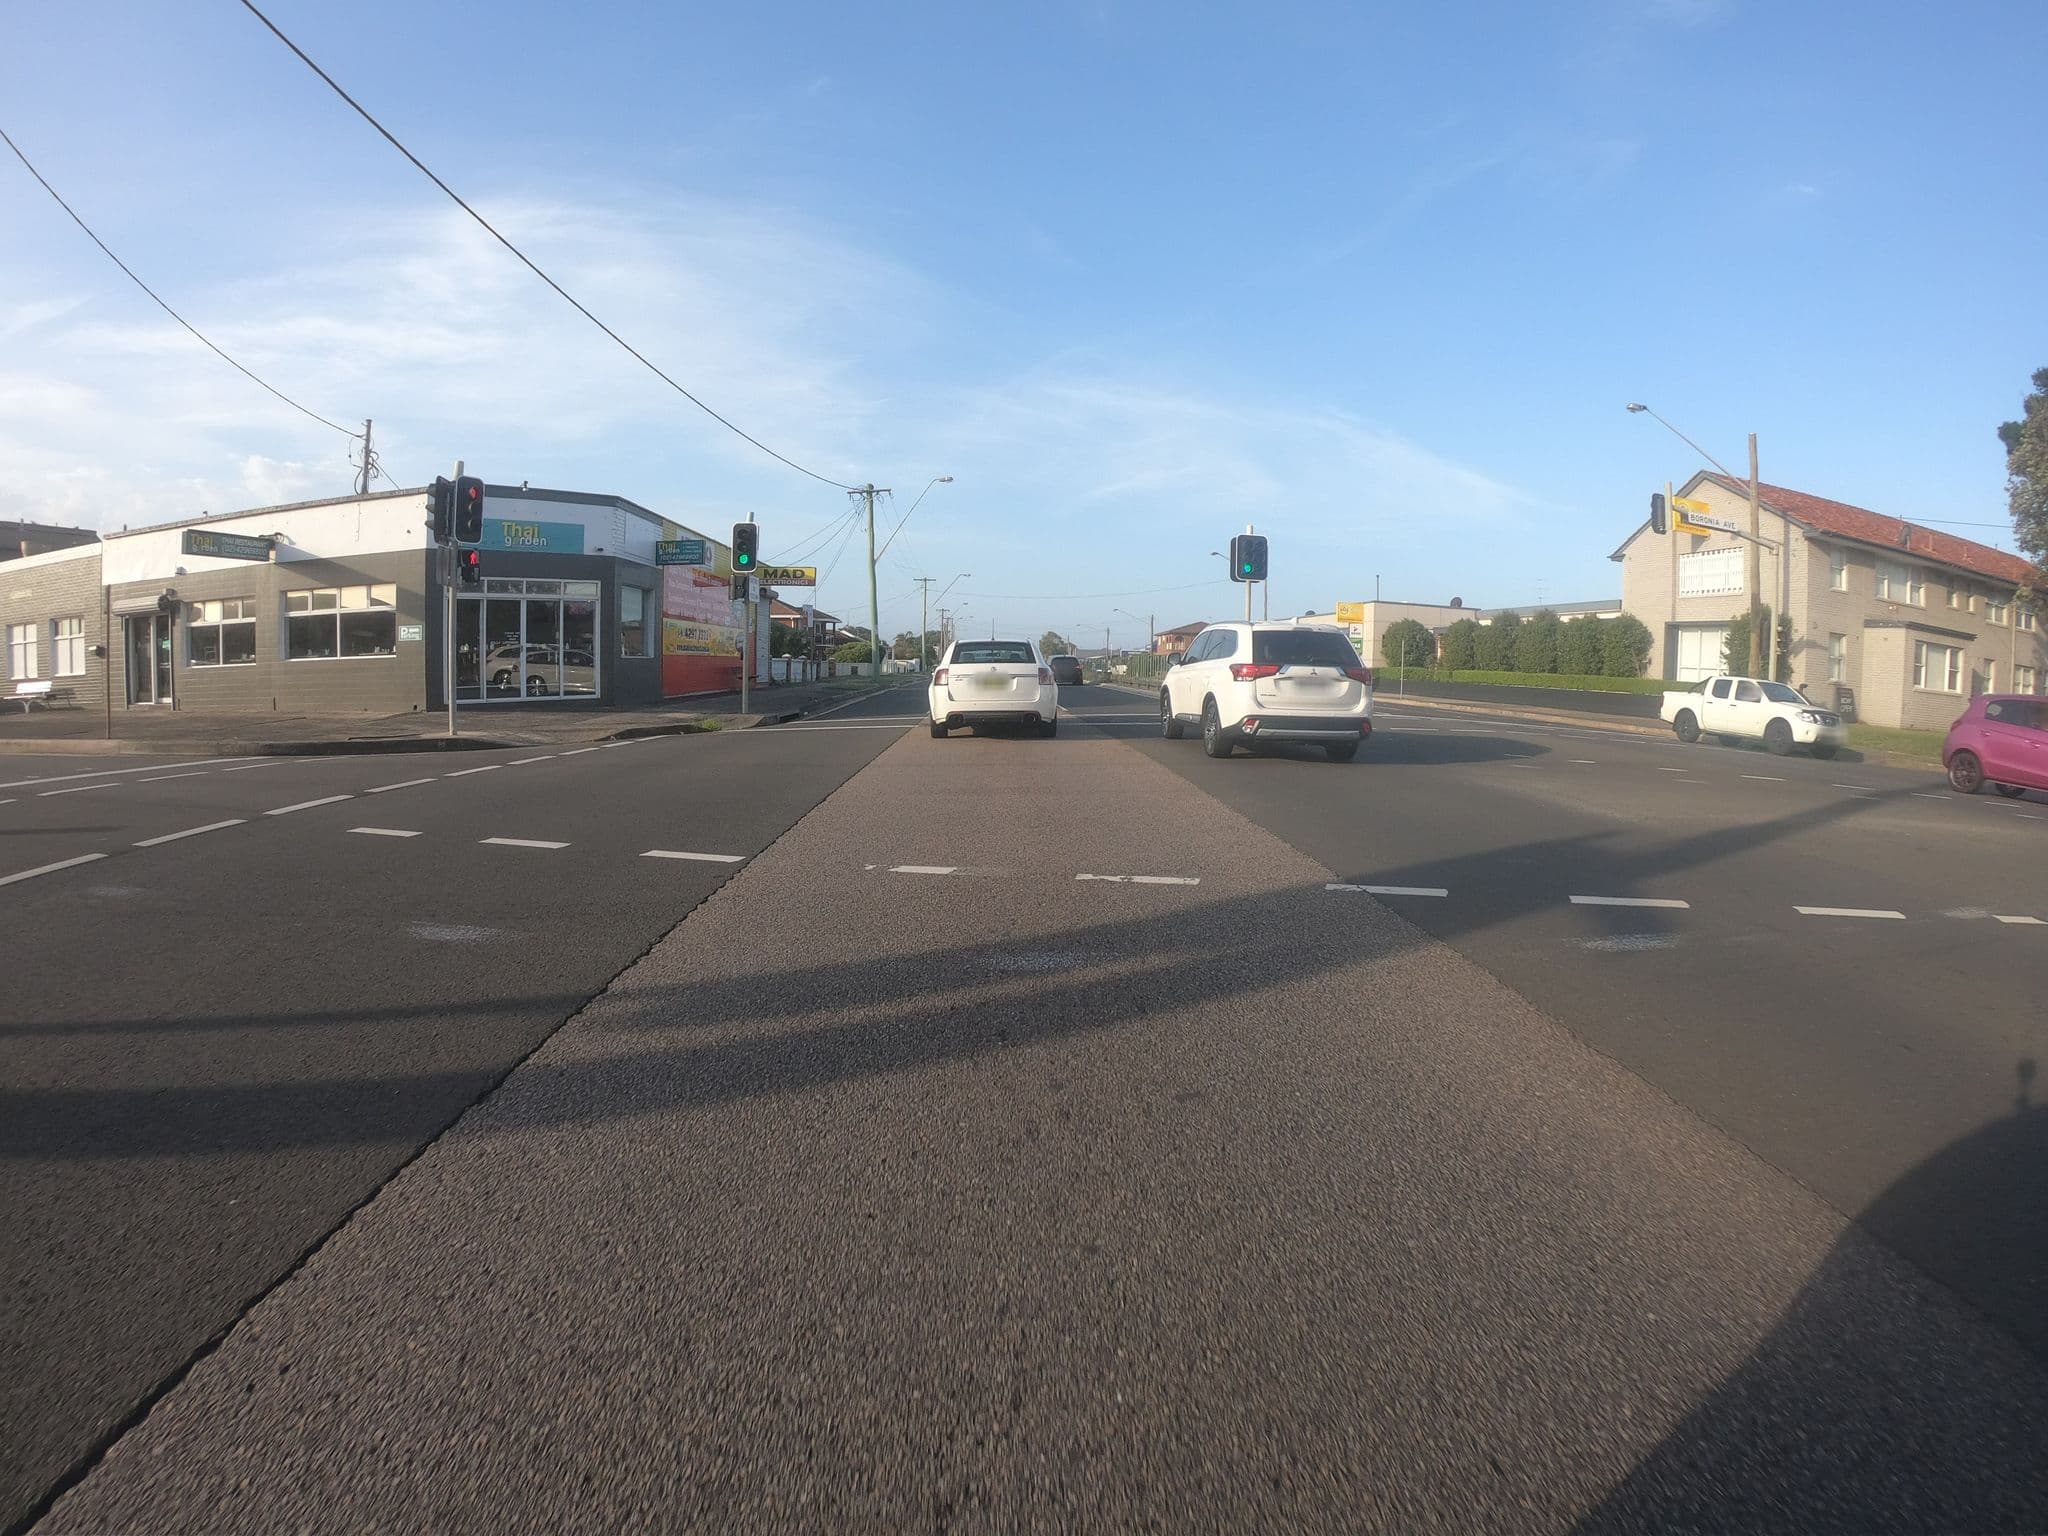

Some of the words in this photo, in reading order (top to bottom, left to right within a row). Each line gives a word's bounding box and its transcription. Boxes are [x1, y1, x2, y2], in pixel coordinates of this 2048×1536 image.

[1690, 513, 1720, 526] BORONIA
[1723, 520, 1736, 529] AVE
[502, 522, 539, 537] Thai
[191, 534, 213, 545] Thai
[505, 536, 547, 547] garden
[192, 545, 219, 553] grden
[763, 568, 806, 578] MAD
